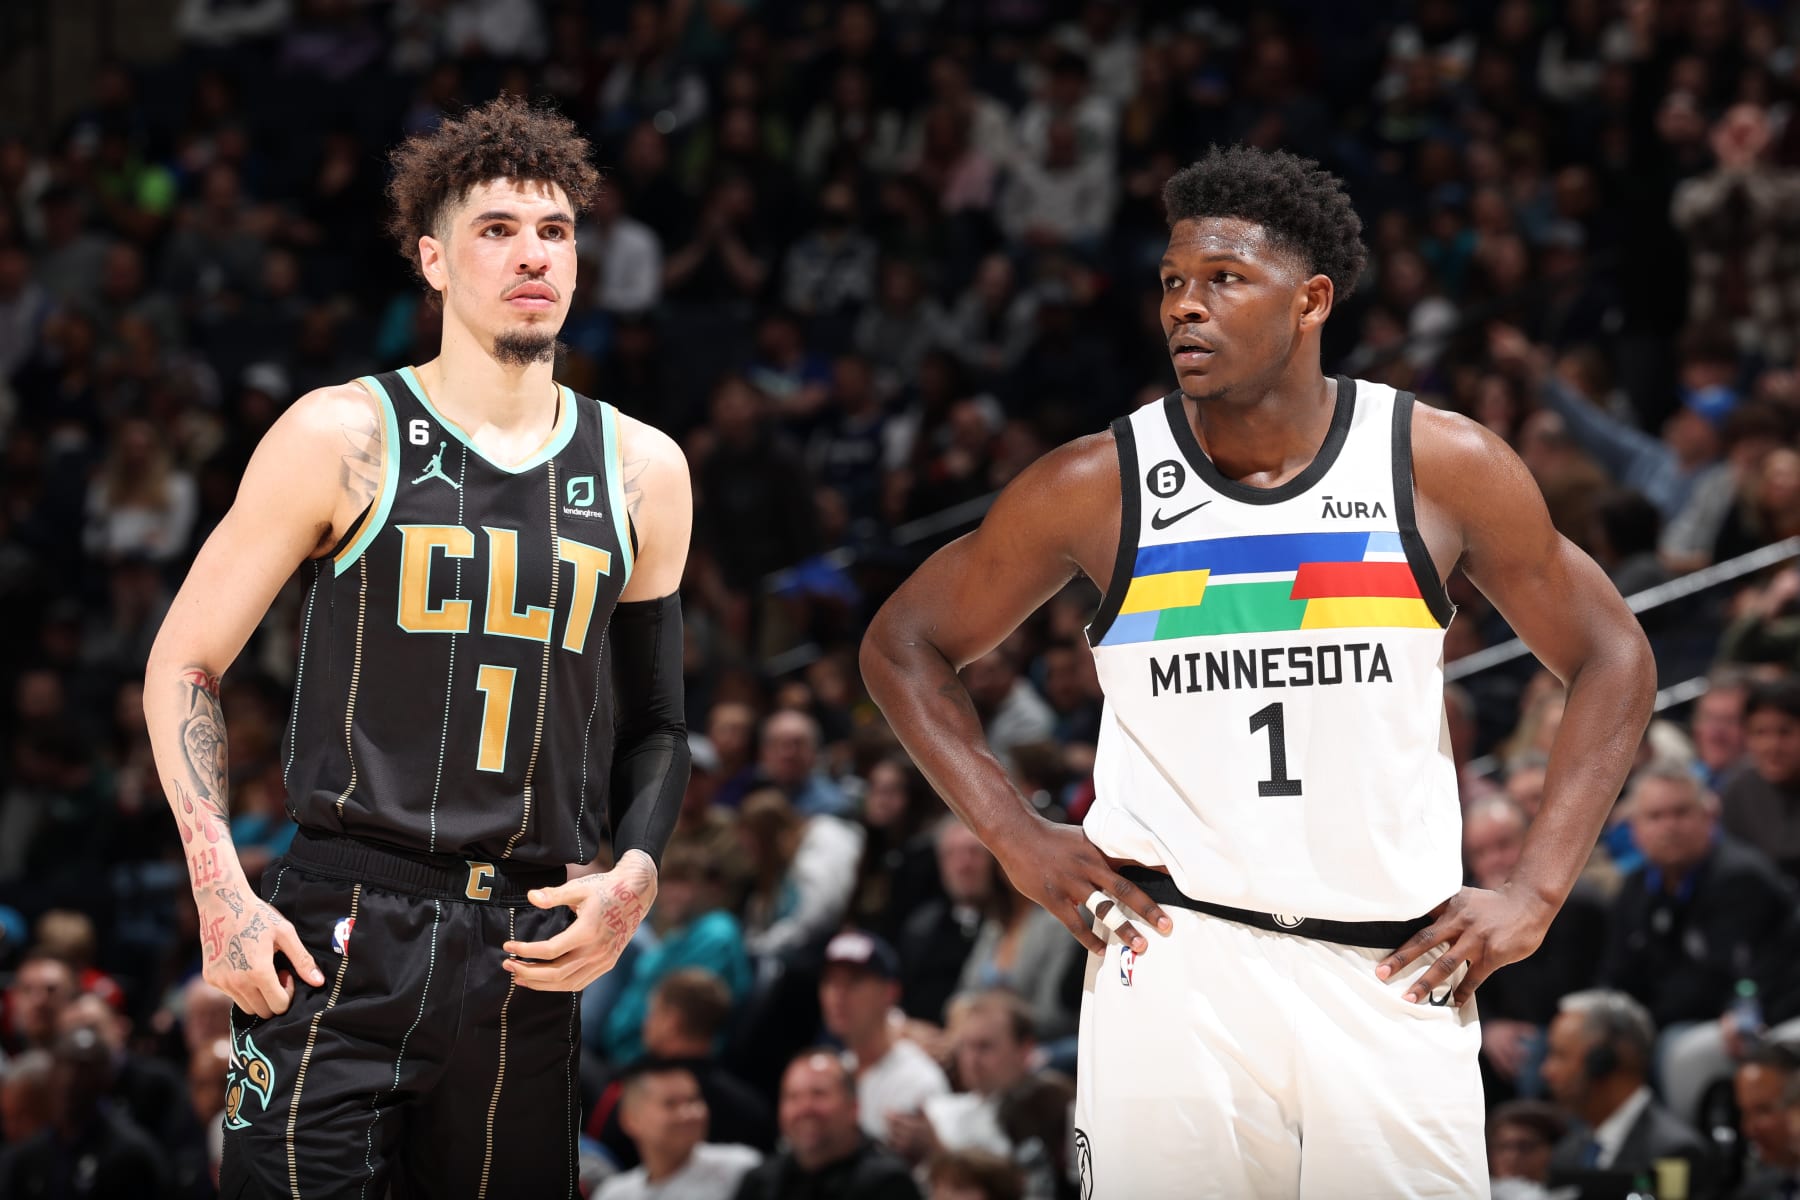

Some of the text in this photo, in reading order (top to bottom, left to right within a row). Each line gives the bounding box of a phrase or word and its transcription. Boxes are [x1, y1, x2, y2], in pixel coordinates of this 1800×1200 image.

[409, 419, 429, 445] 6
[1157, 465, 1176, 493] 6
[563, 506, 602, 518] lendingtree
[395, 525, 611, 654] CLT
[1150, 643, 1392, 696] MINNESOTA
[476, 664, 517, 773] 1
[1249, 702, 1302, 797] 1
[465, 860, 494, 900] C
